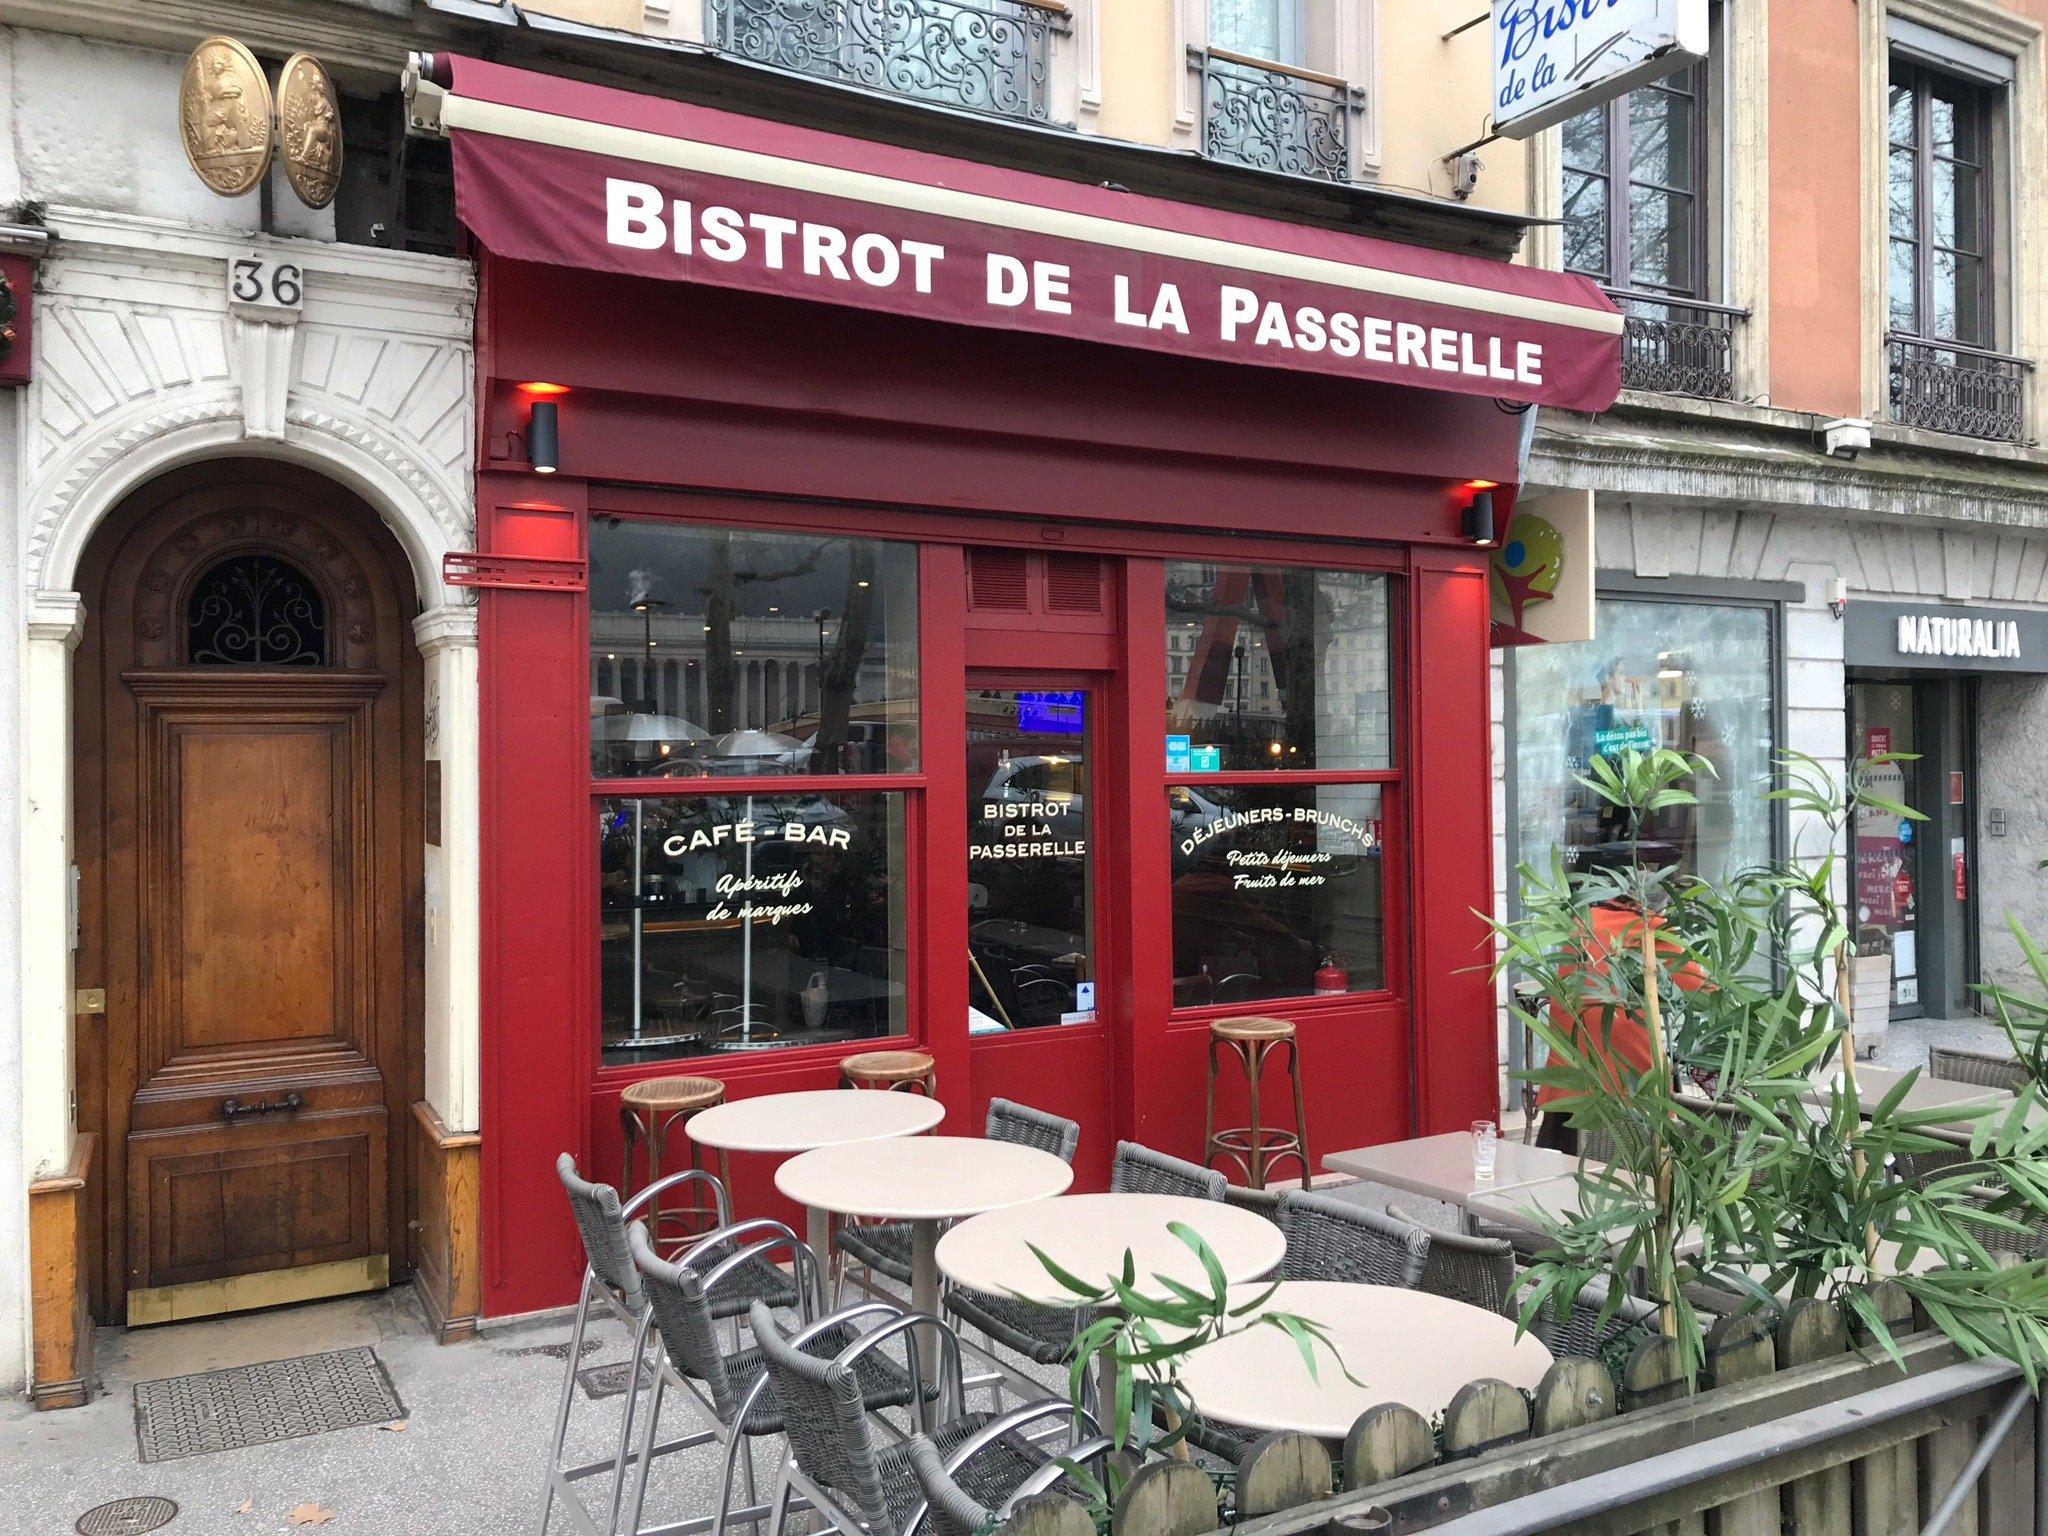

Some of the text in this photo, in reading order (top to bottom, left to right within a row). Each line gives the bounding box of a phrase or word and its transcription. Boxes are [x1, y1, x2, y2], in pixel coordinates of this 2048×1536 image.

[1499, 52, 1557, 108] de la
[232, 259, 301, 306] 36
[605, 177, 1543, 385] BISTROT DE LA PASSERELLE
[1898, 614, 2020, 659] NATURALIA
[983, 802, 1071, 820] BISTROT
[785, 822, 851, 850] BAR
[1004, 824, 1052, 837] DE LA
[969, 840, 1086, 860] PASSERELLE
[1226, 849, 1332, 871] Petits déjeuners
[715, 869, 804, 899] Apéritifs
[1233, 871, 1325, 890] Fruits de mer
[706, 901, 813, 925] de marques
